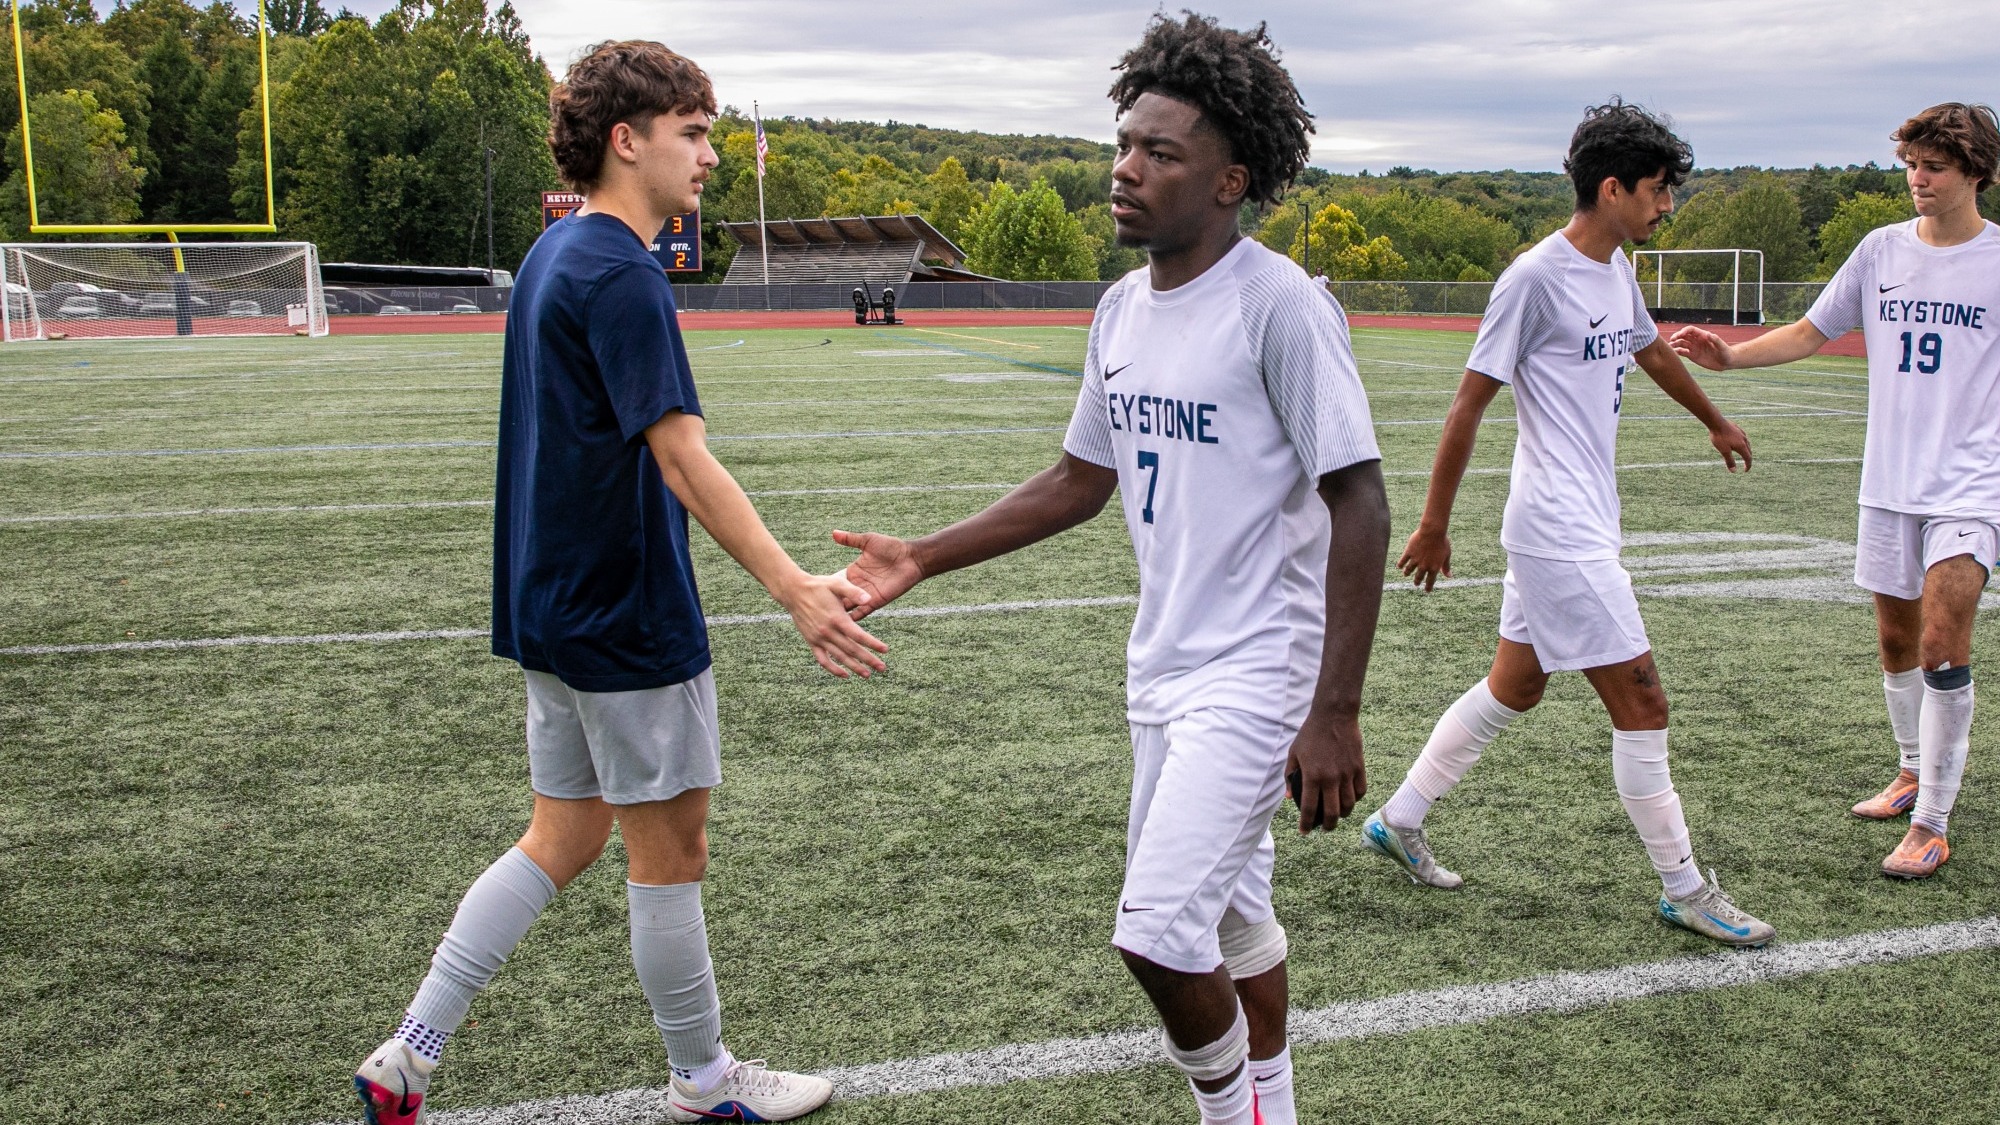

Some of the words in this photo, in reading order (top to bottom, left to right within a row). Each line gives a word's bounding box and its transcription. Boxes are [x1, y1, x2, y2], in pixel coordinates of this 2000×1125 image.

[672, 216, 682, 233] 3
[670, 243, 691, 251] QTR.
[676, 252, 686, 268] 2
[1879, 299, 1986, 330] KEYSTONE
[1898, 331, 1942, 374] 19
[1613, 366, 1625, 414] 5
[1107, 392, 1219, 444] EYSTONE
[1137, 450, 1159, 525] 7
